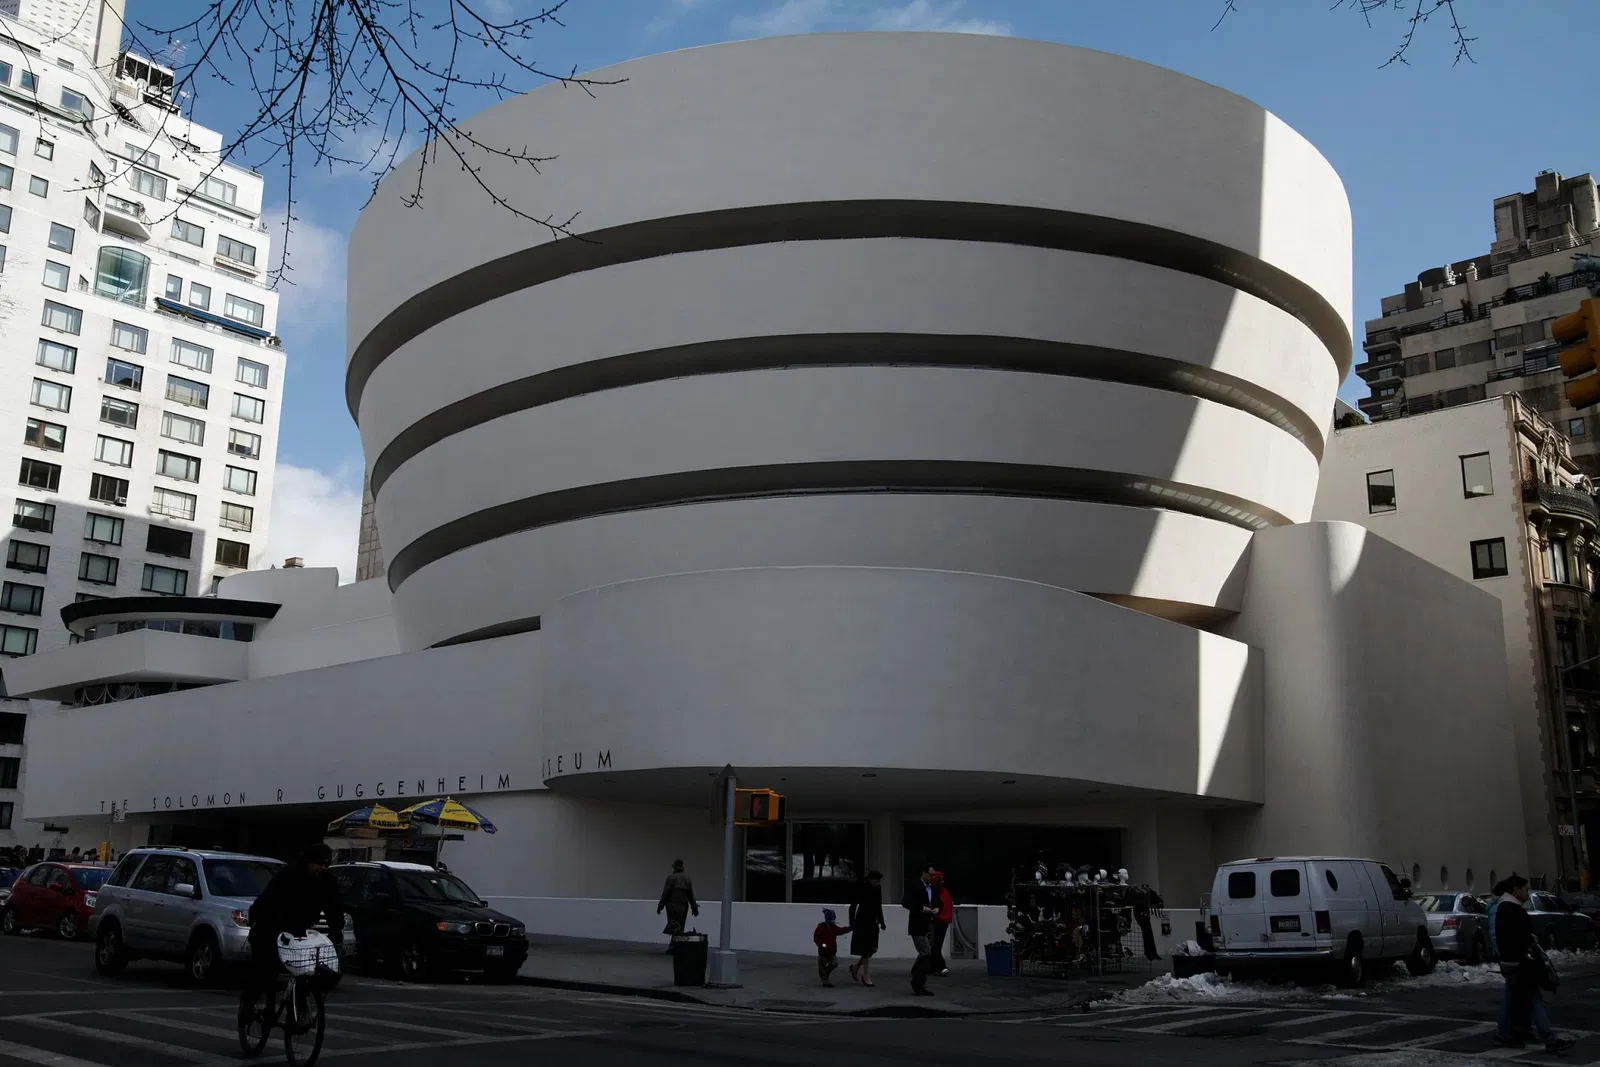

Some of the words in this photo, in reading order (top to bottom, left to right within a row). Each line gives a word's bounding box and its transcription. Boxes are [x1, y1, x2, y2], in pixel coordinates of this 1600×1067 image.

[101, 799, 128, 812] THE
[153, 792, 246, 809] SOLOMON
[277, 789, 283, 802] R
[317, 773, 510, 800] GUGGENHEIM
[543, 749, 612, 778] SEUM
